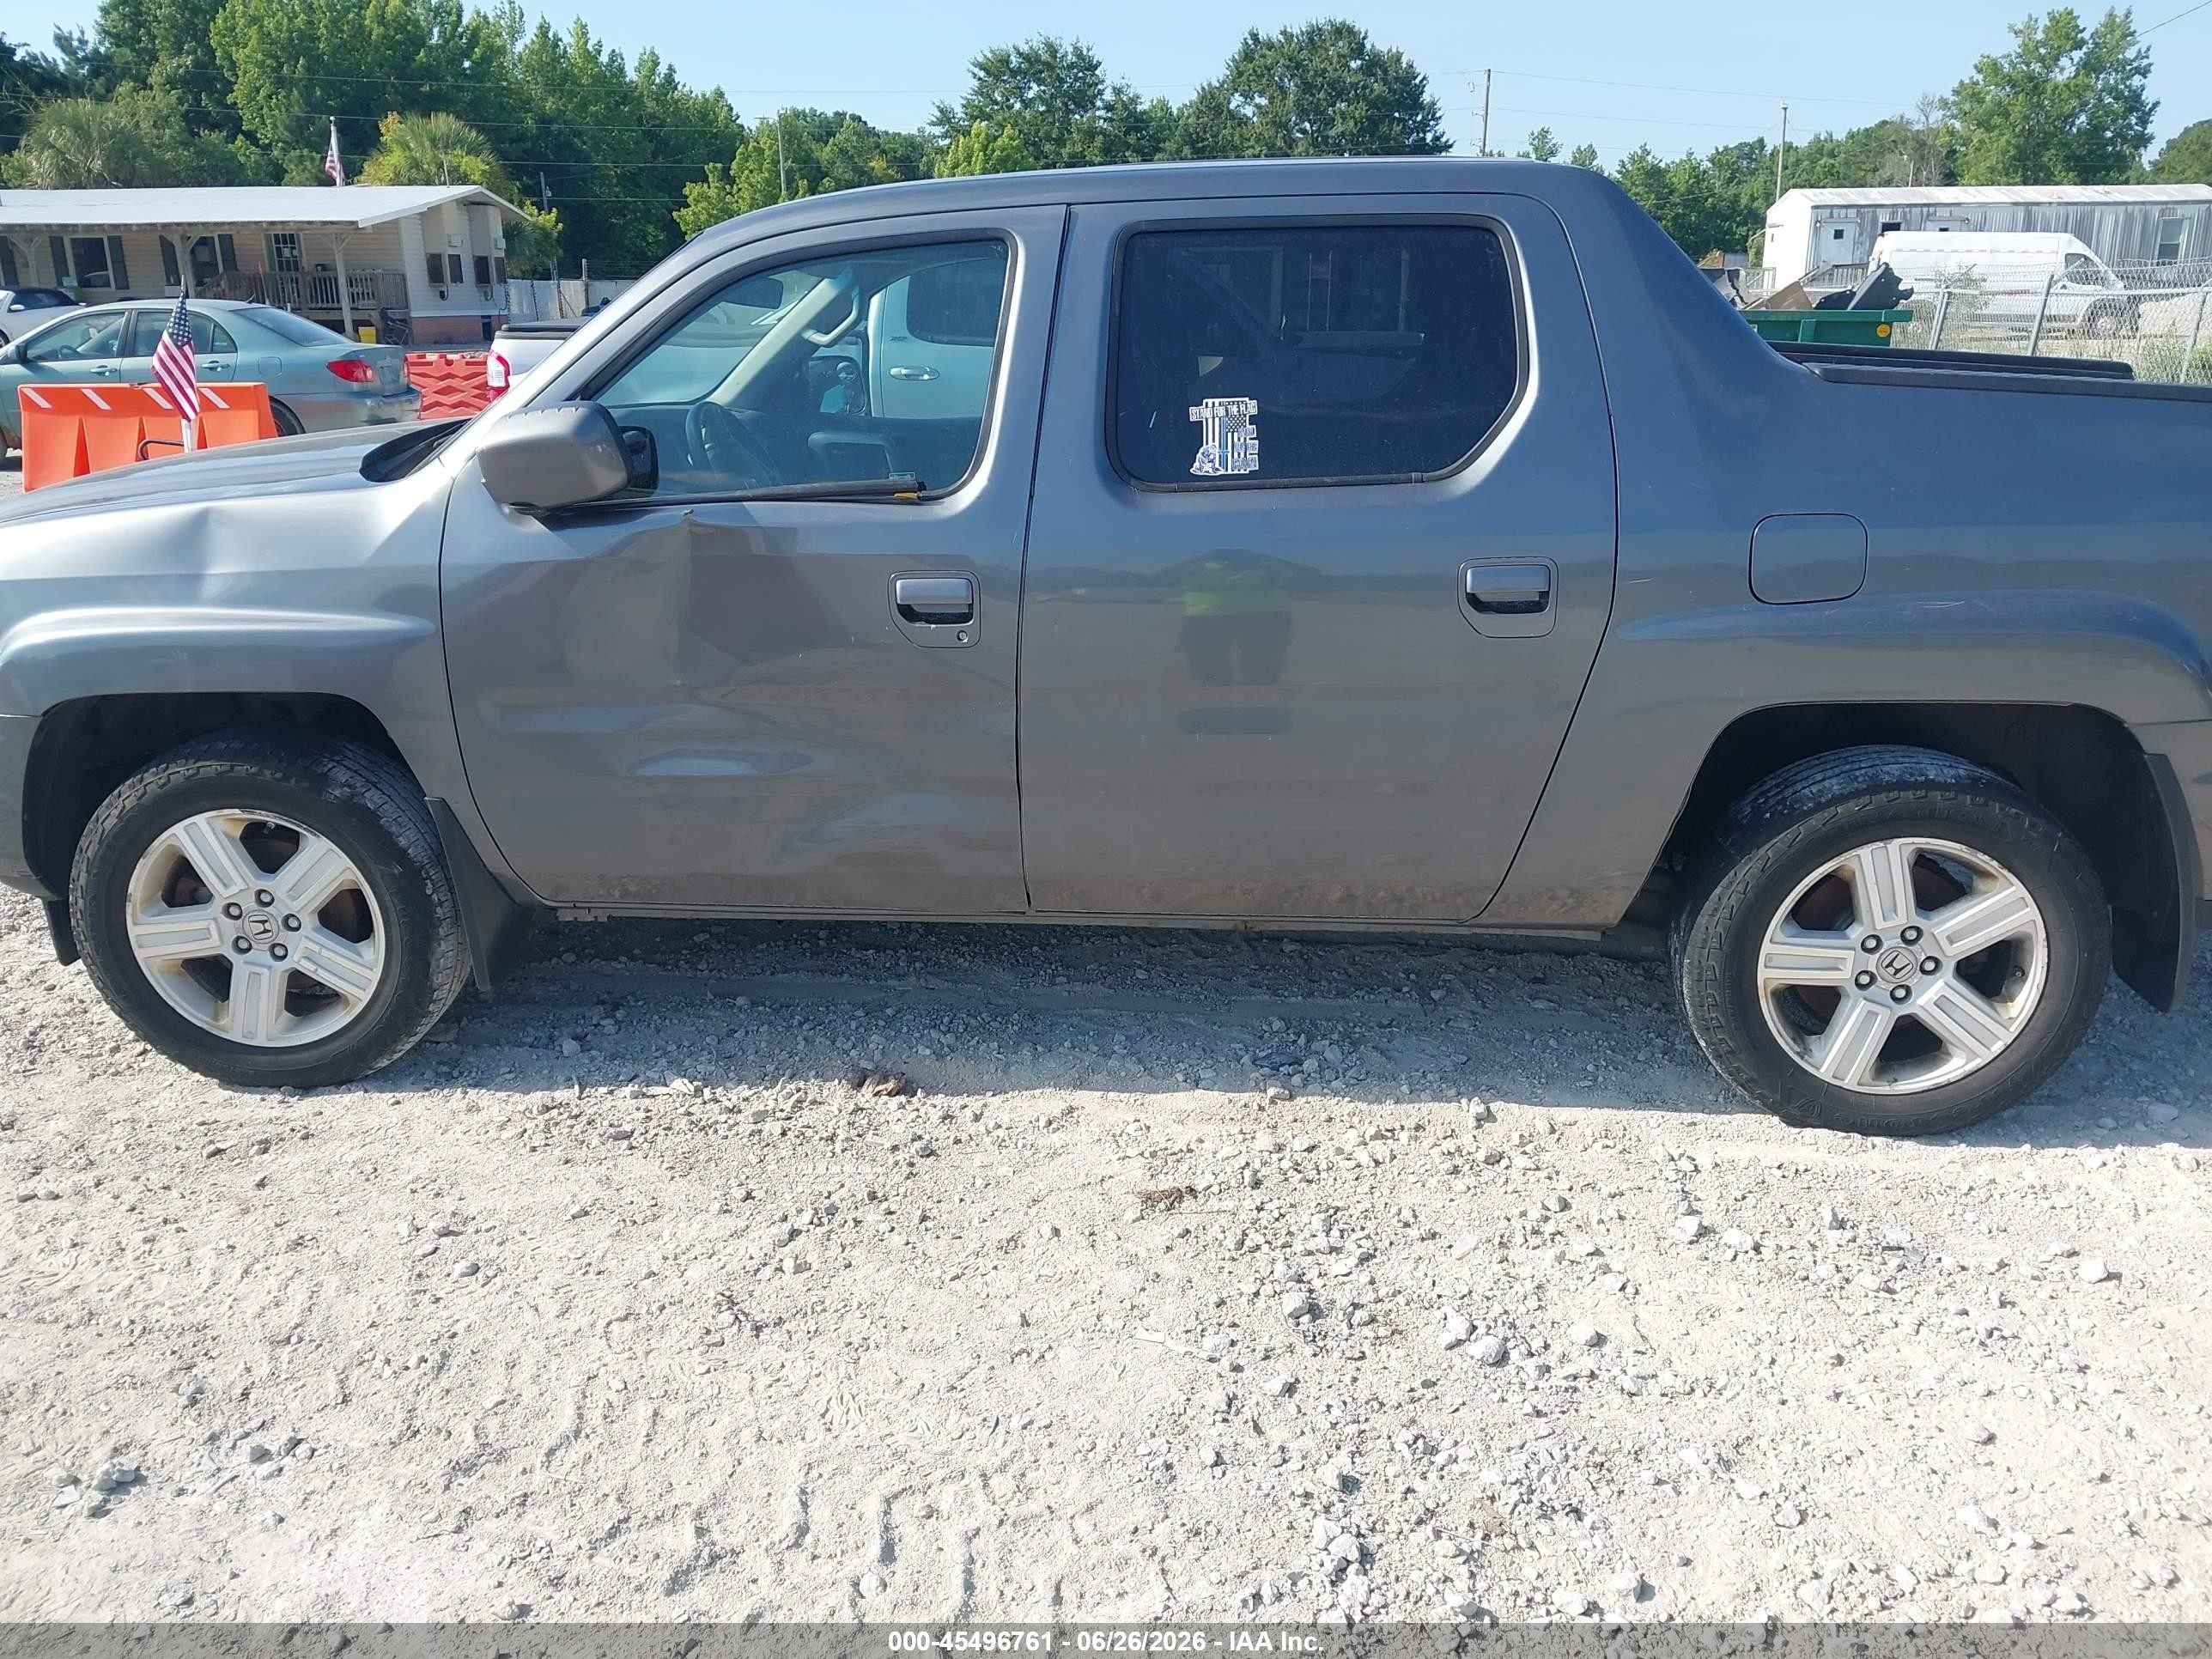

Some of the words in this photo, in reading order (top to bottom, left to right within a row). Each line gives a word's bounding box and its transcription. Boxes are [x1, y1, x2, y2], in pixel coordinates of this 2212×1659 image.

[1191, 407, 1213, 420] STAND
[1214, 406, 1226, 417] FOR
[1227, 404, 1239, 416] THE
[1239, 402, 1256, 415] FLAG
